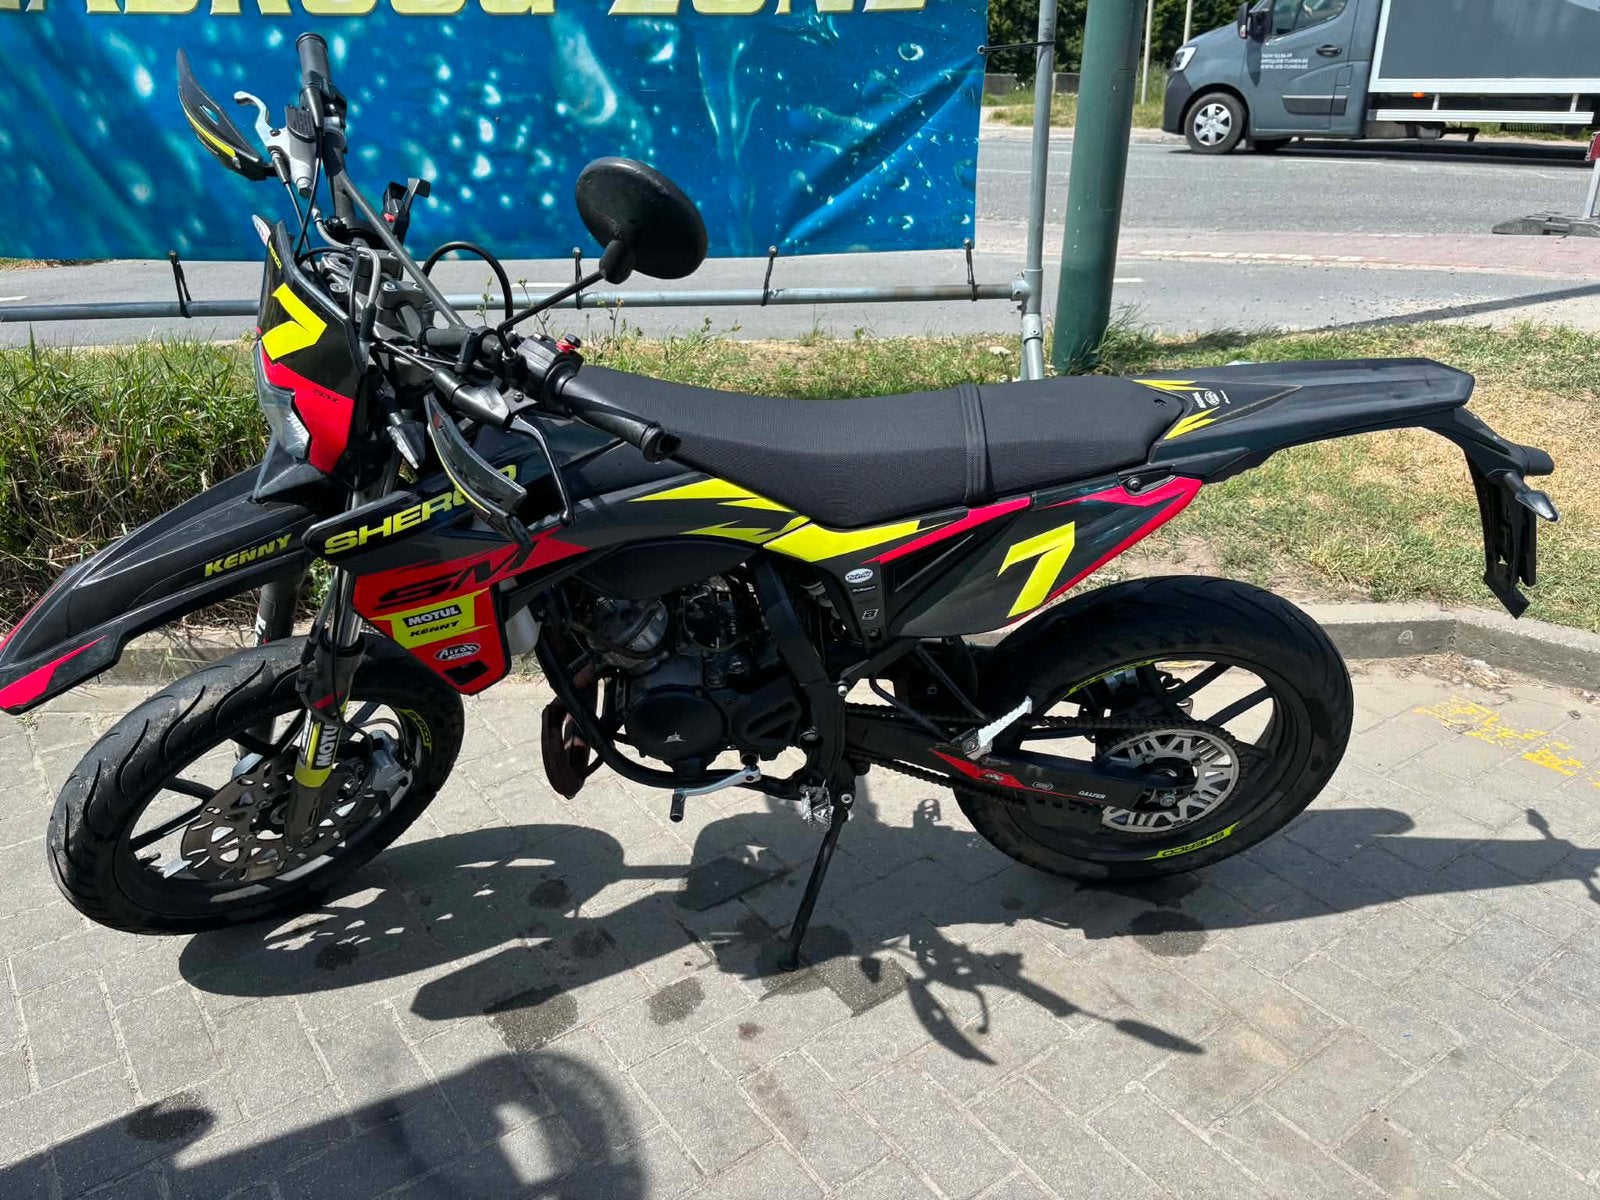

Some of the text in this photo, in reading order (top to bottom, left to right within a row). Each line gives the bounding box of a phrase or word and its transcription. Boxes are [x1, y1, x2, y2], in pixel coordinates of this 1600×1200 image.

[204, 532, 293, 577] KENNY
[997, 520, 1076, 618] 7
[408, 606, 460, 626] MOTUL
[410, 620, 460, 637] KENNY
